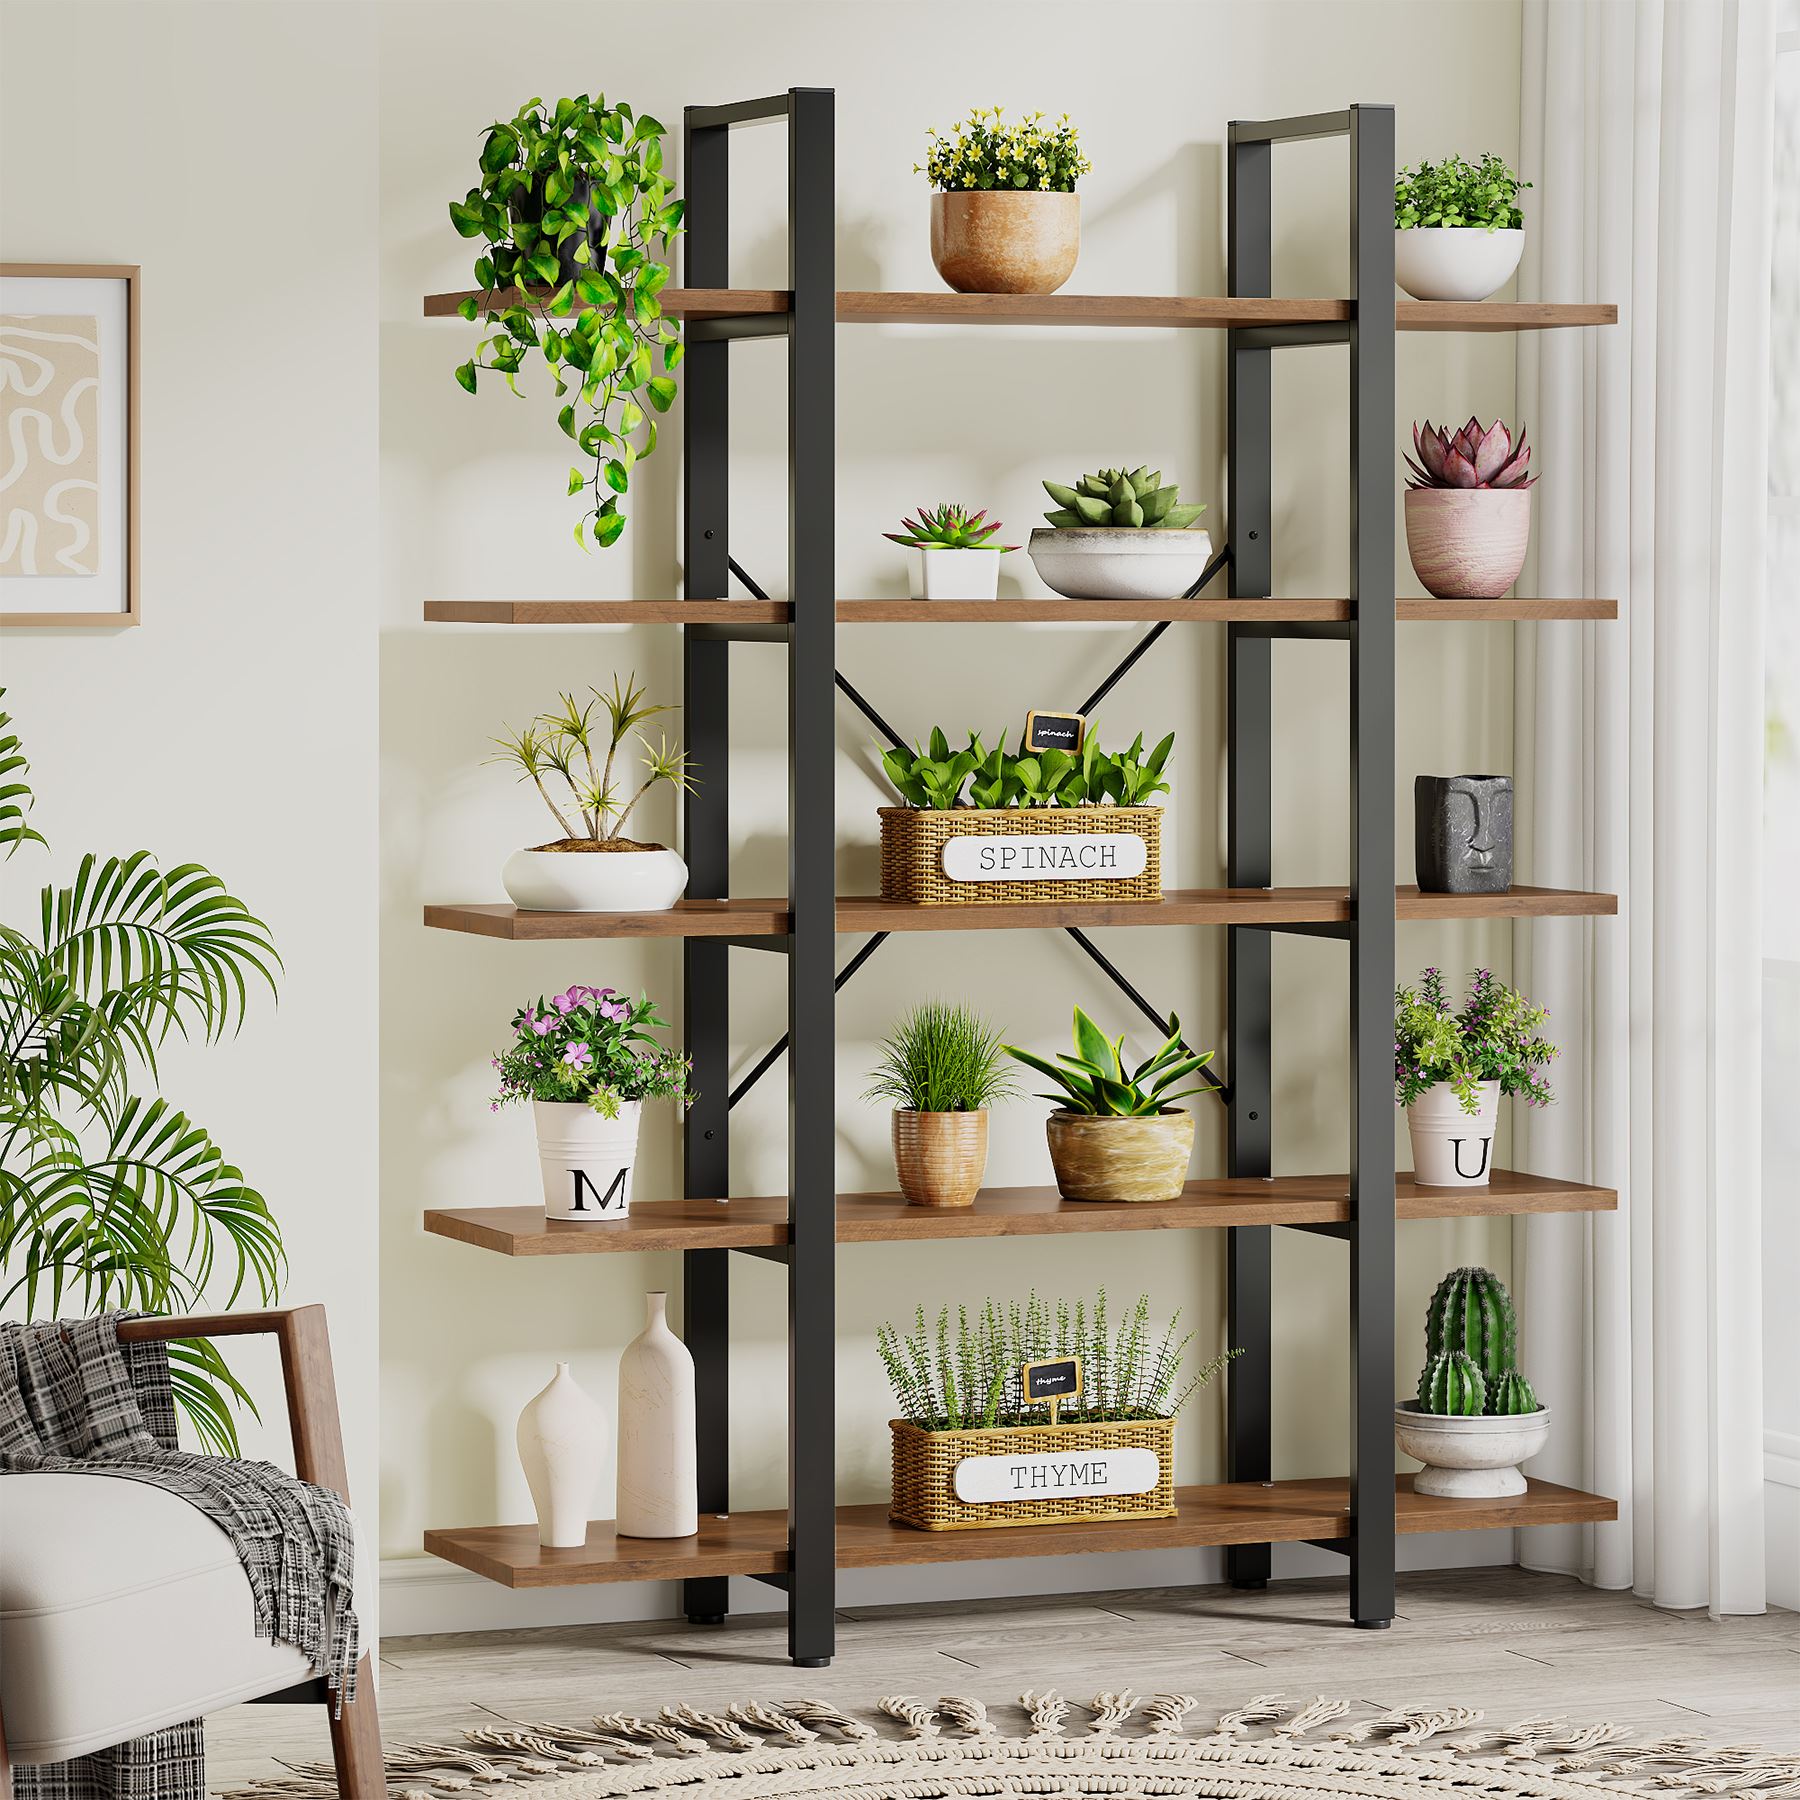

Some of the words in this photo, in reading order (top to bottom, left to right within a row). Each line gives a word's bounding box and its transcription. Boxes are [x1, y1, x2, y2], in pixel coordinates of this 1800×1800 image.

[1036, 728, 1075, 738] spinach
[980, 845, 1117, 870] SPINACH
[1447, 1136, 1492, 1179] U
[565, 1166, 631, 1211] M
[1035, 1375, 1067, 1386] thyme
[1010, 1461, 1108, 1490] THYME
